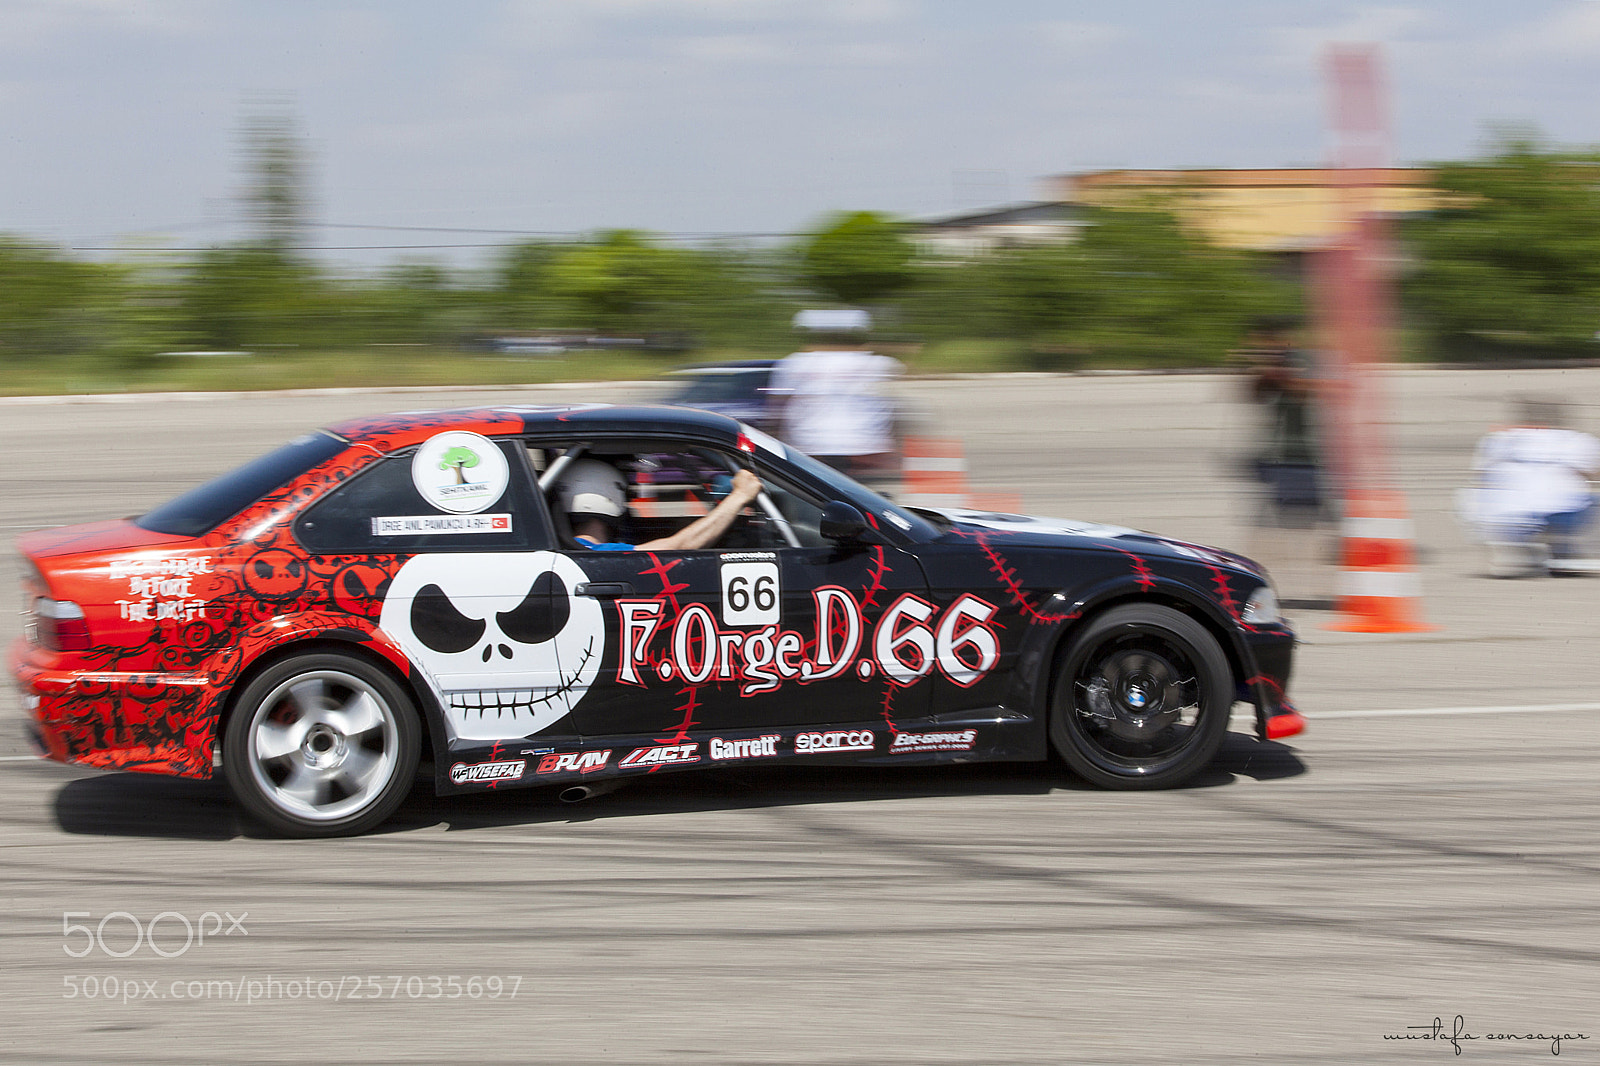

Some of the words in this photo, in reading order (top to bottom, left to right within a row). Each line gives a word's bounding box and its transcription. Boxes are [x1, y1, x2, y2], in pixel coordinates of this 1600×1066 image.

[727, 575, 776, 612] 66
[710, 735, 777, 760] Garrett
[795, 731, 874, 753] sparco
[467, 763, 525, 779] WISEFAB
[538, 751, 611, 772] BPLAN
